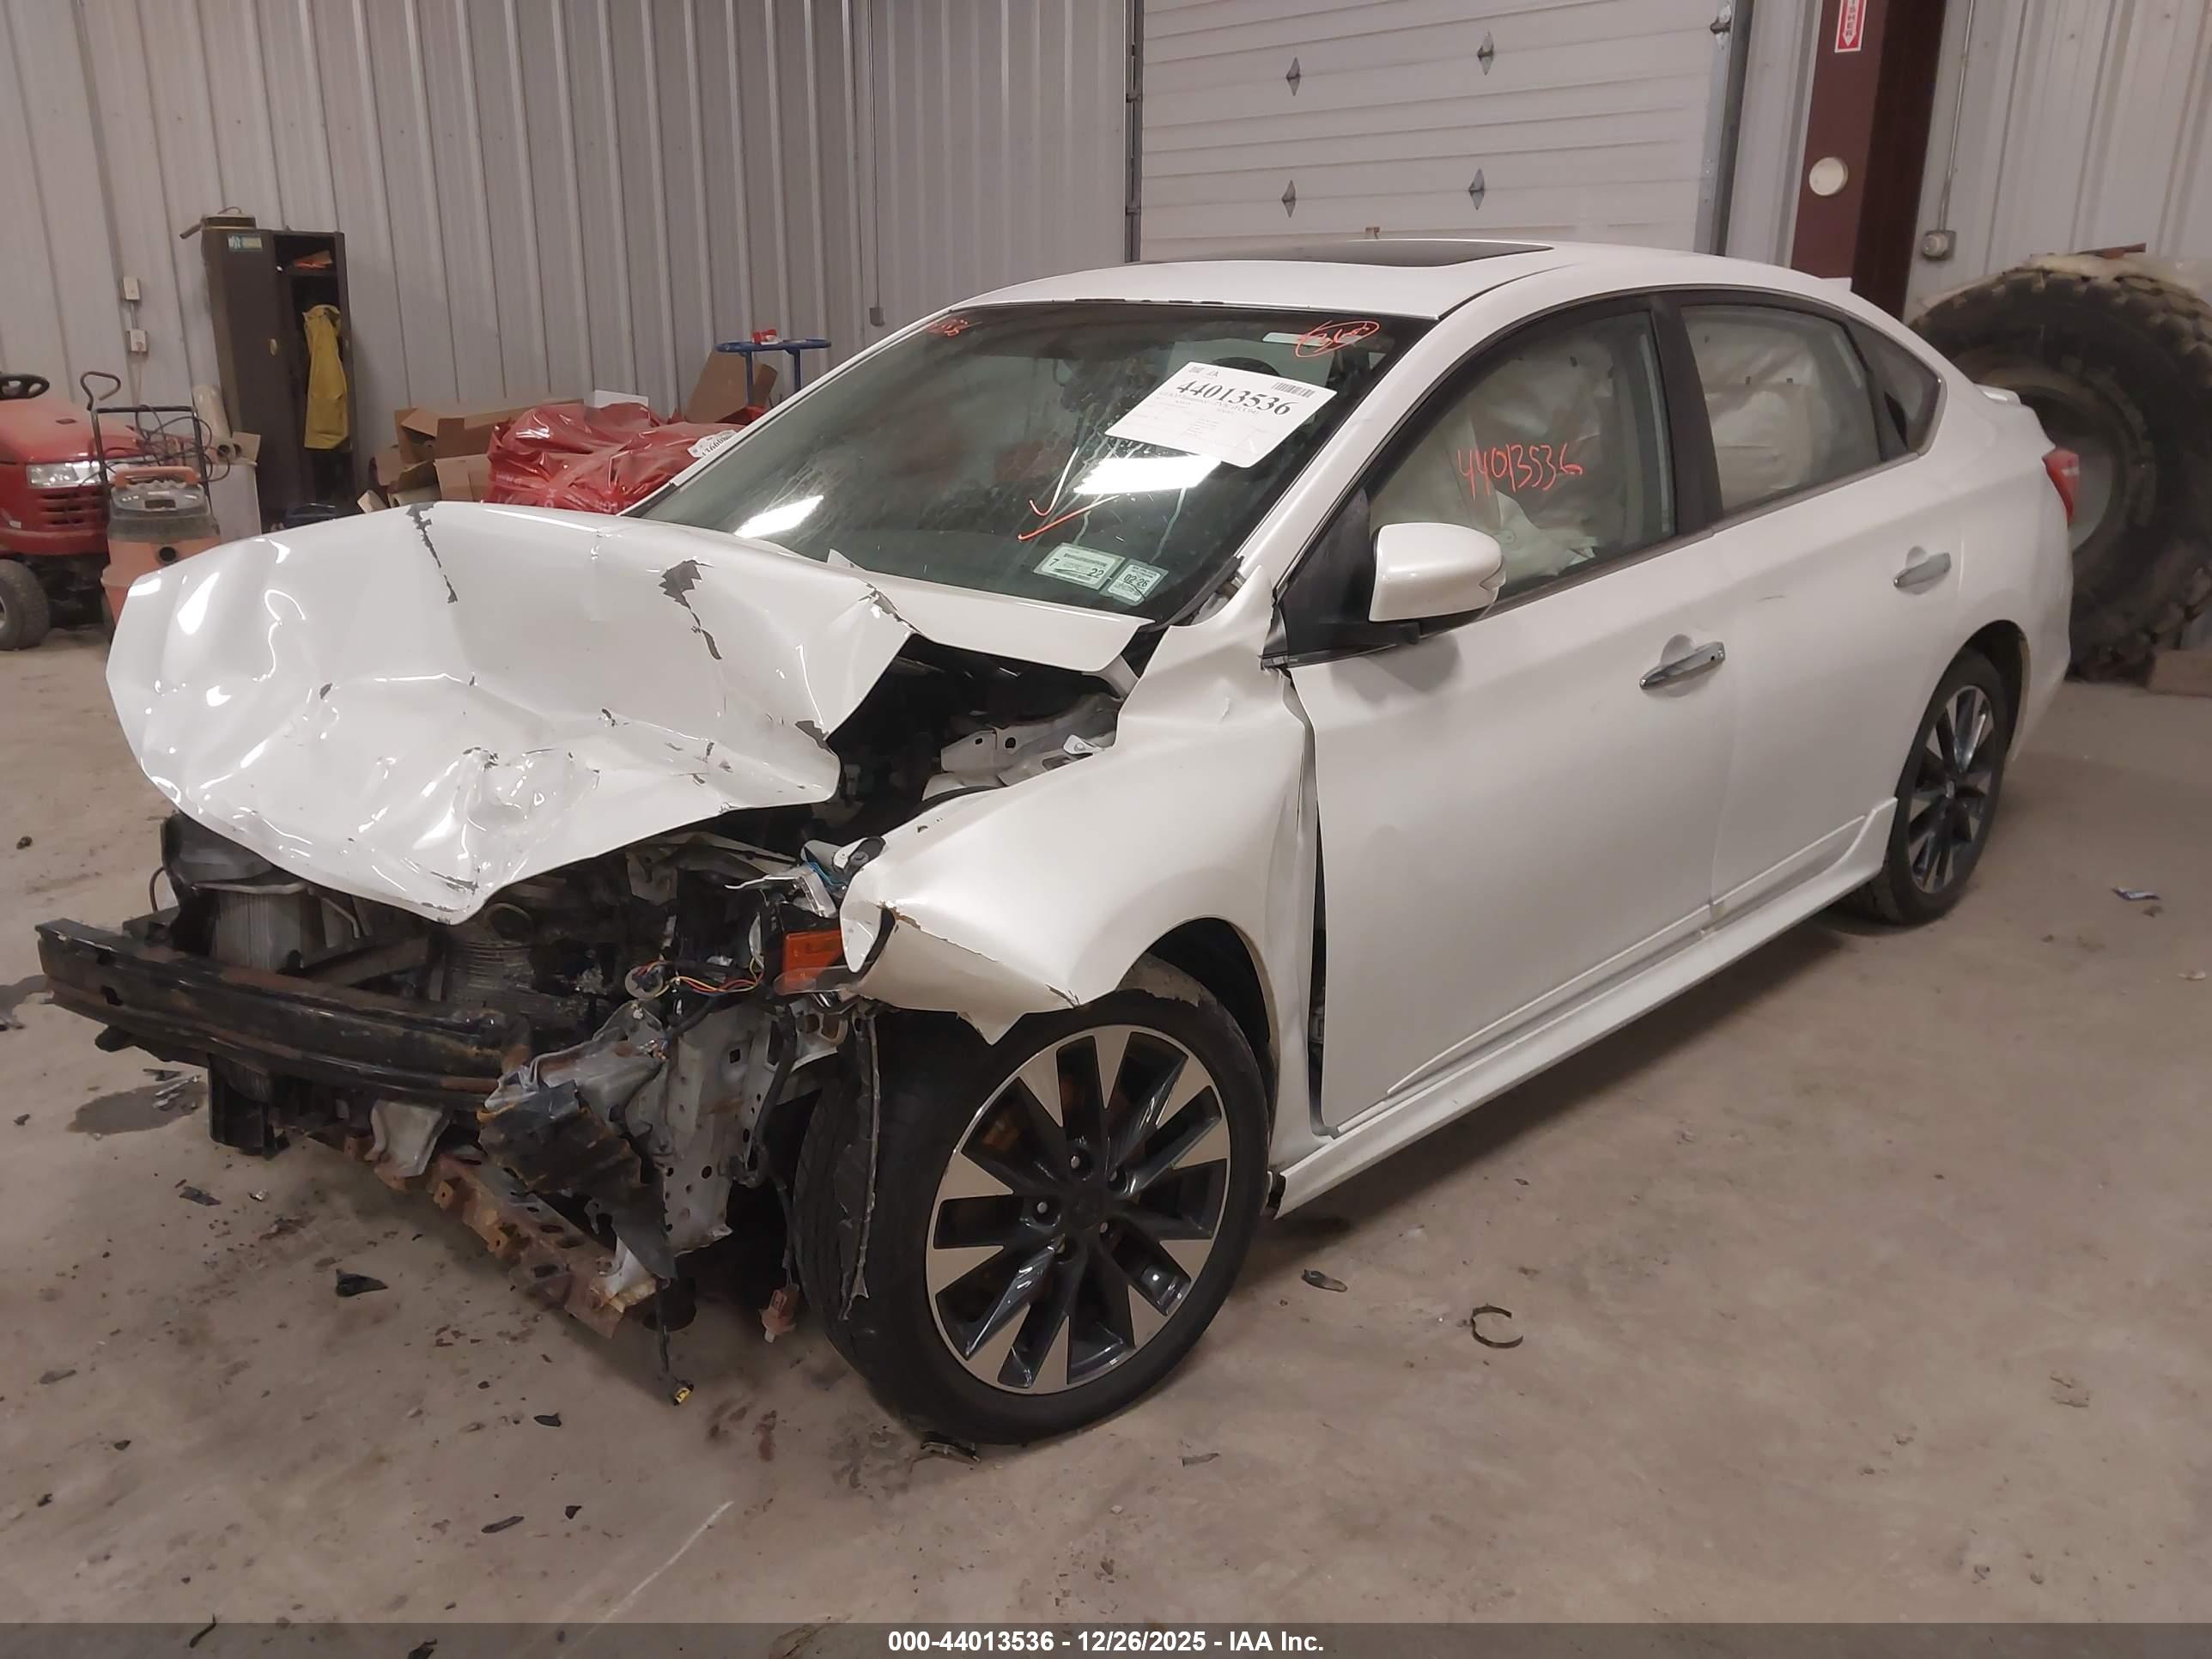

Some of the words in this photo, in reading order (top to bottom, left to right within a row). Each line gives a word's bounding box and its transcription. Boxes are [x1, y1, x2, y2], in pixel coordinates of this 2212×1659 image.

[1176, 380, 1299, 416] 44013536
[1457, 442, 1583, 501] 44013536
[1088, 568, 1105, 579] 22
